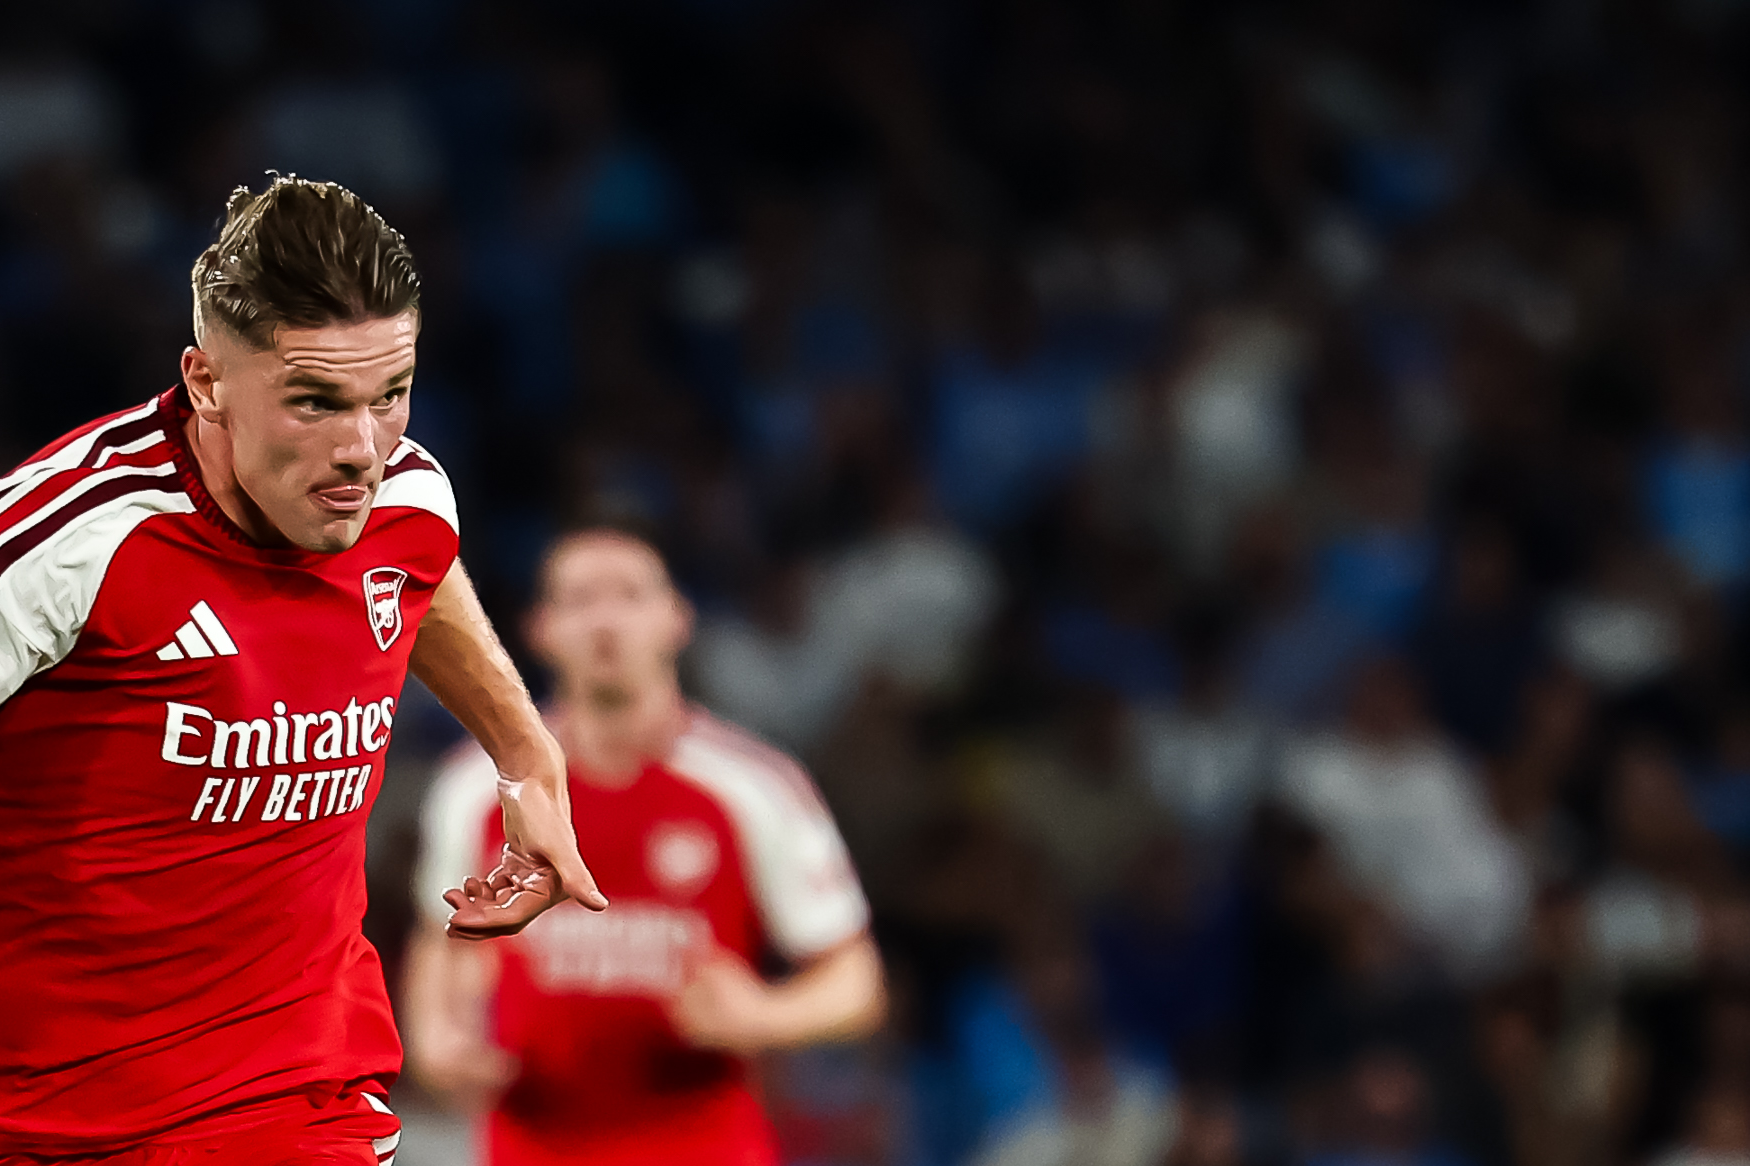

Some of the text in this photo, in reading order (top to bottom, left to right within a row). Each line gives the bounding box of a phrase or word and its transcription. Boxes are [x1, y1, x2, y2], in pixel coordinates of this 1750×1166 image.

[162, 696, 395, 769] Emirates
[190, 764, 372, 823] FLY BETTER
